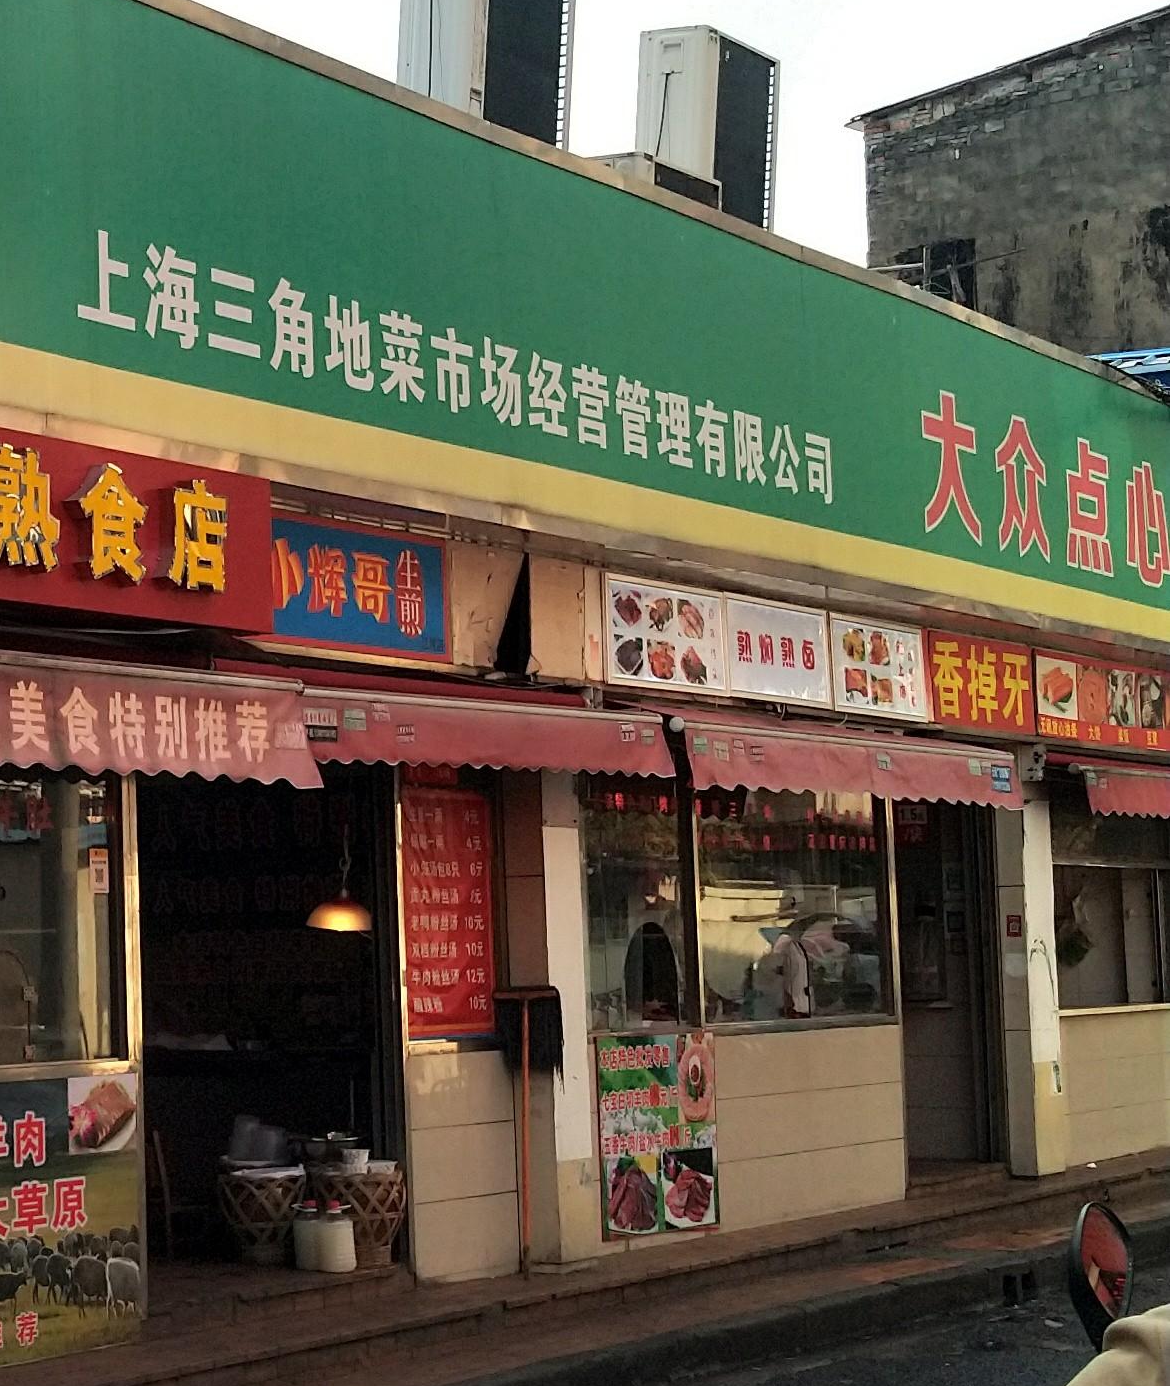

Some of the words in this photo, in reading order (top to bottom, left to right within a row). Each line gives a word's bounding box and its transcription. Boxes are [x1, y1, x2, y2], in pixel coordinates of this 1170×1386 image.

[76, 229, 833, 505] 上海三角地菜市场经营管理有限公司
[918, 389, 1170, 590] 大众点心
[272, 537, 392, 623] 小辉哥
[397, 549, 422, 636] 生煎
[931, 642, 1029, 727] 香掉牙
